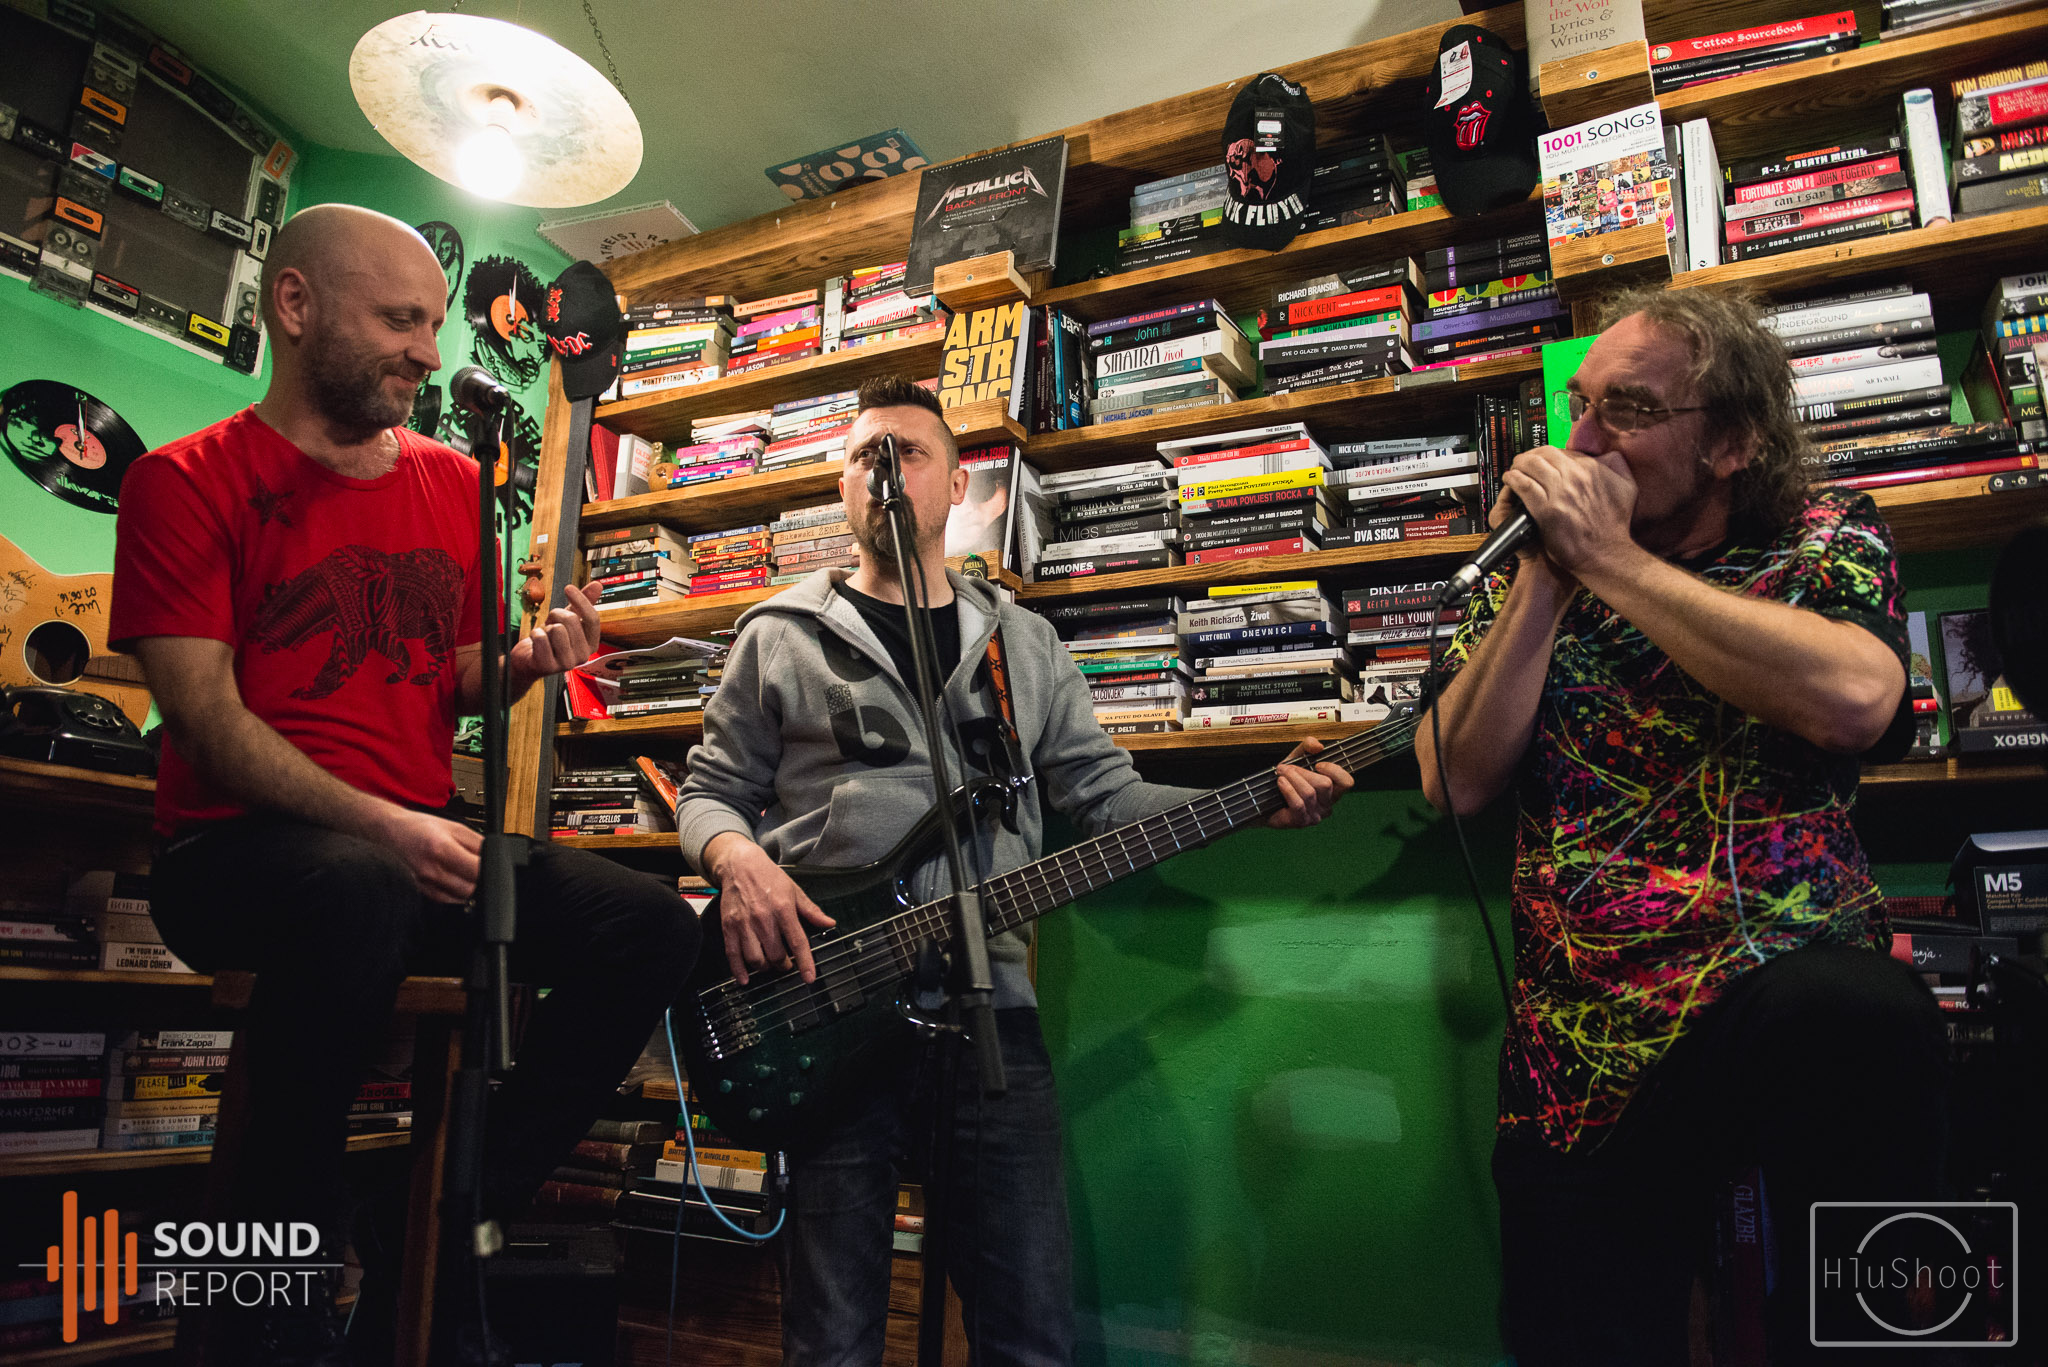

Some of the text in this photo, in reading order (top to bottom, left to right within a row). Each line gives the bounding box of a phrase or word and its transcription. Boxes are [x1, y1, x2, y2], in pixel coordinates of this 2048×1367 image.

[1549, 8, 1571, 22] the
[1551, 9, 1614, 35] Lyrics &
[1551, 27, 1615, 48] Writings
[1691, 23, 1804, 50] Tattoo Sourcebook
[1662, 65, 1740, 83] MADONNA CONFESSIONS
[1955, 77, 1977, 97] KIM
[1979, 67, 2023, 89] GORDON
[1544, 111, 1655, 153] 1001 SONGS
[1794, 156, 1828, 169] DEATH
[1816, 163, 1876, 186] JOHN FOGERTY
[921, 164, 1049, 227] METALLICA
[1741, 176, 1804, 200] FORTUNATE SON
[945, 186, 1028, 212] BACK FRONT
[1245, 193, 1304, 226] FLOYD
[1754, 218, 1792, 232] BACH
[1278, 281, 1339, 302] RICHARD BRANSON
[656, 302, 668, 310] Clint
[1294, 302, 1336, 318] NICK KENT
[1433, 304, 1457, 314] Laurent
[1489, 309, 1531, 323] Muzikofilija
[943, 300, 1024, 350] ARM
[1134, 326, 1159, 342] John
[667, 346, 682, 354] PARK
[1455, 338, 1487, 348] Eminem
[2008, 338, 2025, 351] JIMI
[942, 339, 1014, 388] STR
[1104, 344, 1160, 375] SINATRA
[726, 362, 765, 377] DAVID JASON
[642, 373, 685, 386] MONTY PYTHON
[1098, 378, 1109, 387] U2
[1099, 395, 1134, 411] BOND
[1104, 407, 1154, 423] MICHAEL JACKSON
[1809, 402, 1837, 420] IDOL
[1339, 444, 1365, 454] NICK CAVE
[1919, 439, 1958, 448] BEAUTIFUL
[1823, 451, 1853, 463] JOVI
[1216, 489, 1302, 508] TAJNA POVIJEST ROCKA
[779, 524, 840, 542] Bukowski ŽENE
[1059, 526, 1099, 543] Miles
[1354, 528, 1400, 543] DVA SRCA
[1234, 545, 1269, 554] POJMOVNIK
[1041, 562, 1094, 576] RAMONES
[1189, 610, 1270, 627] Keith Richards Život
[1382, 614, 1404, 626] NEIL
[1242, 626, 1292, 637] DNEVNICI
[598, 815, 621, 823] 2CELLOS
[1984, 873, 2022, 892] M5
[110, 901, 134, 909] BOB
[136, 947, 166, 956] YOUR MAN
[116, 959, 172, 969] LEONARD COHEN
[161, 1039, 213, 1048] Frank Zappa
[182, 1056, 204, 1067] JOHN
[137, 1076, 198, 1088] PLEASE KILL ME
[704, 1152, 730, 1161] SINGLES
